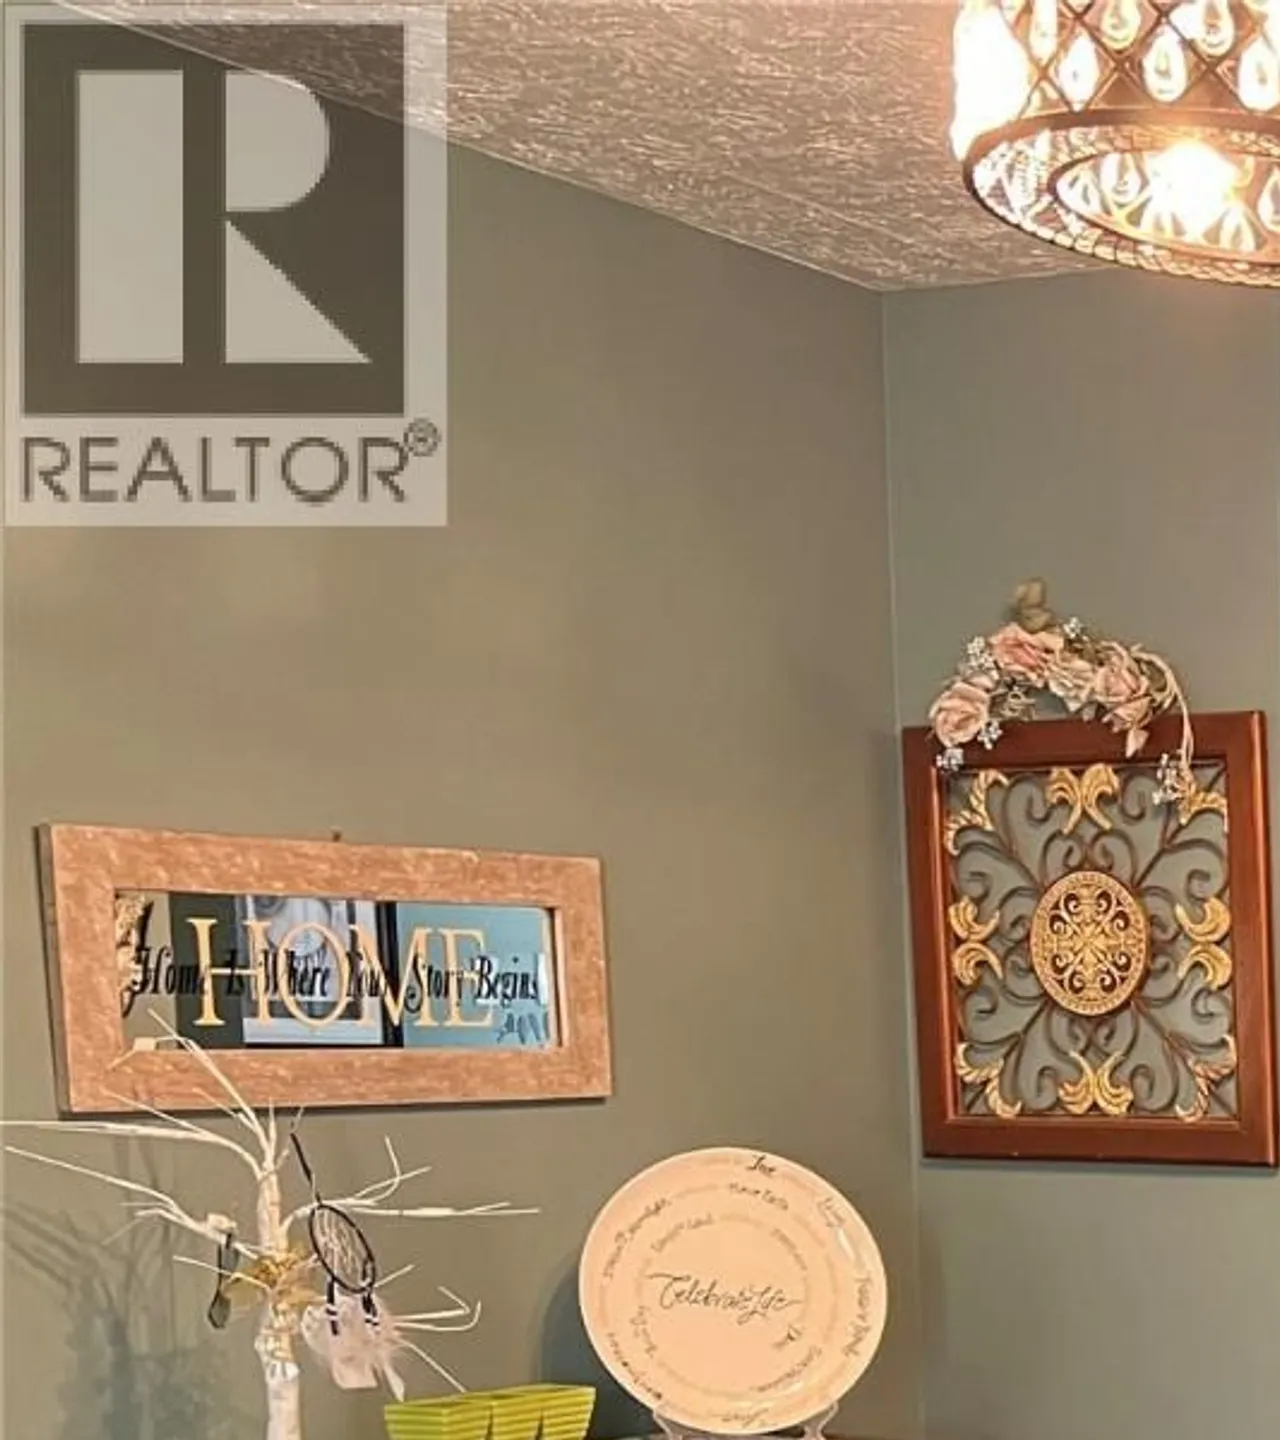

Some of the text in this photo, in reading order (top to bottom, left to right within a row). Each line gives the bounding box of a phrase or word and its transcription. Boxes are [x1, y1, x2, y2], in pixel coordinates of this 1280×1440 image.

[186, 917, 494, 1028] HOME
[346, 950, 386, 997] You
[470, 954, 540, 1008] Begins
